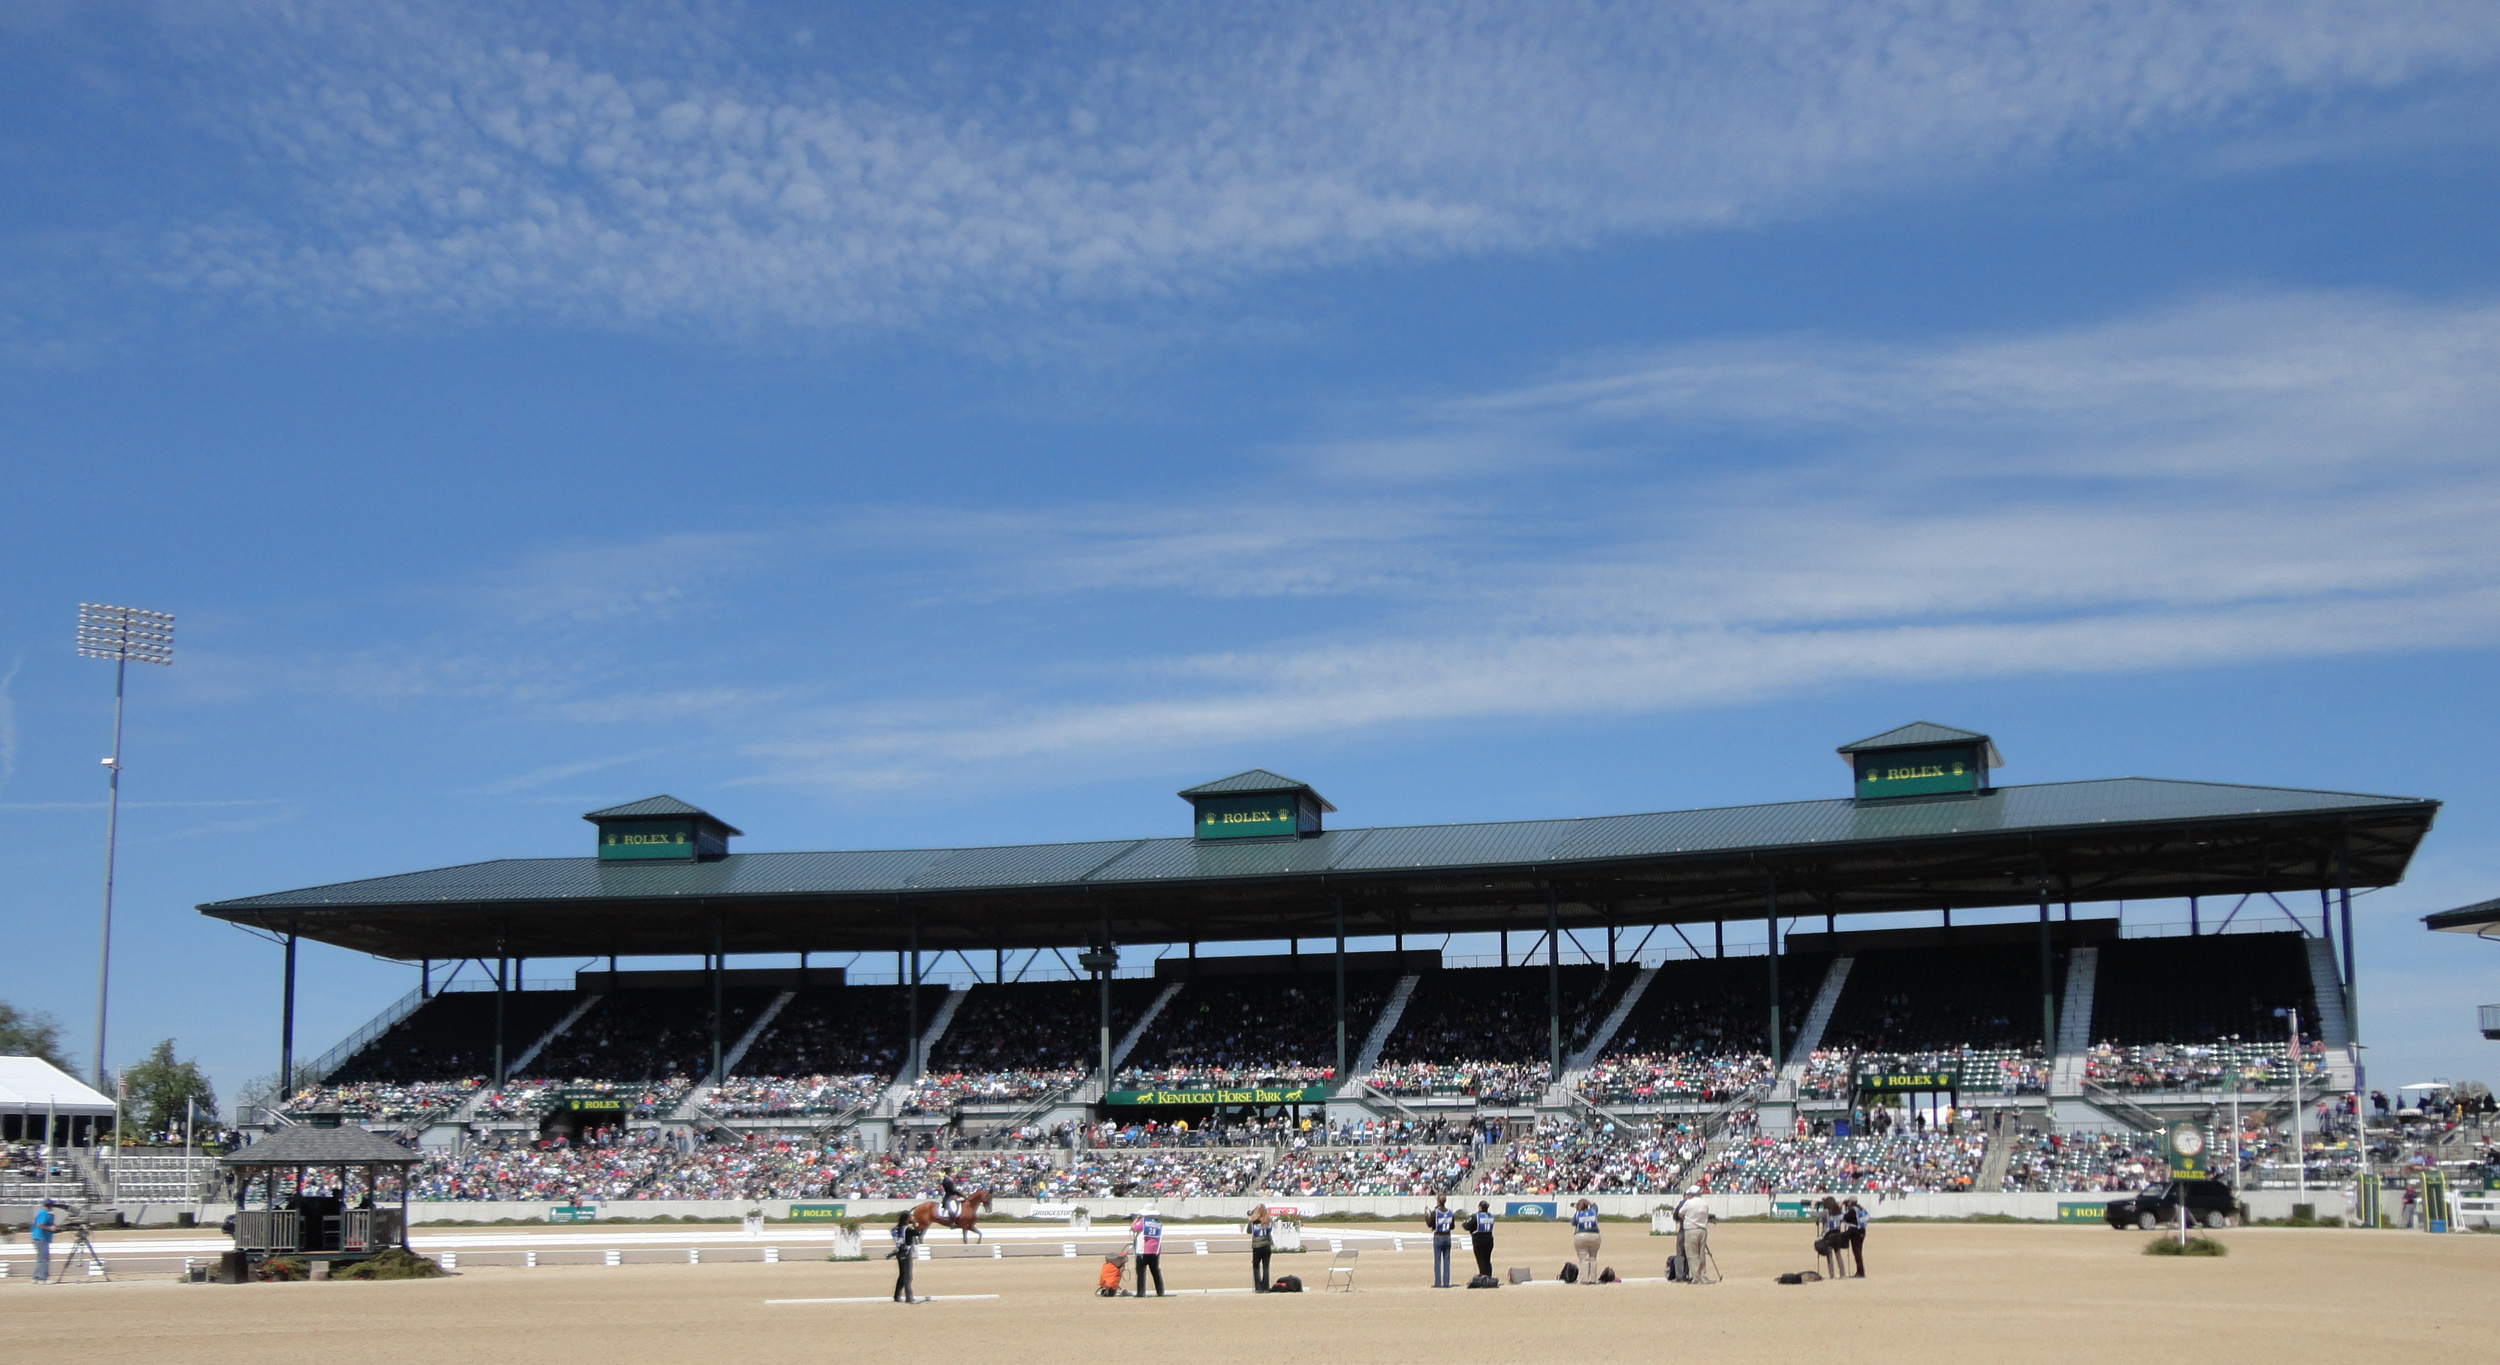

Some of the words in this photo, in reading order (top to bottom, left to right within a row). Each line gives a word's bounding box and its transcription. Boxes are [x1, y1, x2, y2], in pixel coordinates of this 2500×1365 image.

[1886, 766, 1944, 780] ROLEX
[1223, 811, 1271, 824] ROLEX
[624, 834, 669, 845] ROLEX
[1888, 1075, 1932, 1086] ROLEX
[1158, 1091, 1215, 1104] KENTUCKY
[1217, 1090, 1252, 1103] HORSE
[1255, 1089, 1281, 1102] PARK
[584, 1100, 620, 1109] ROLEX
[2173, 1170, 2206, 1179] ROLEX
[803, 1209, 833, 1217] ROLEX
